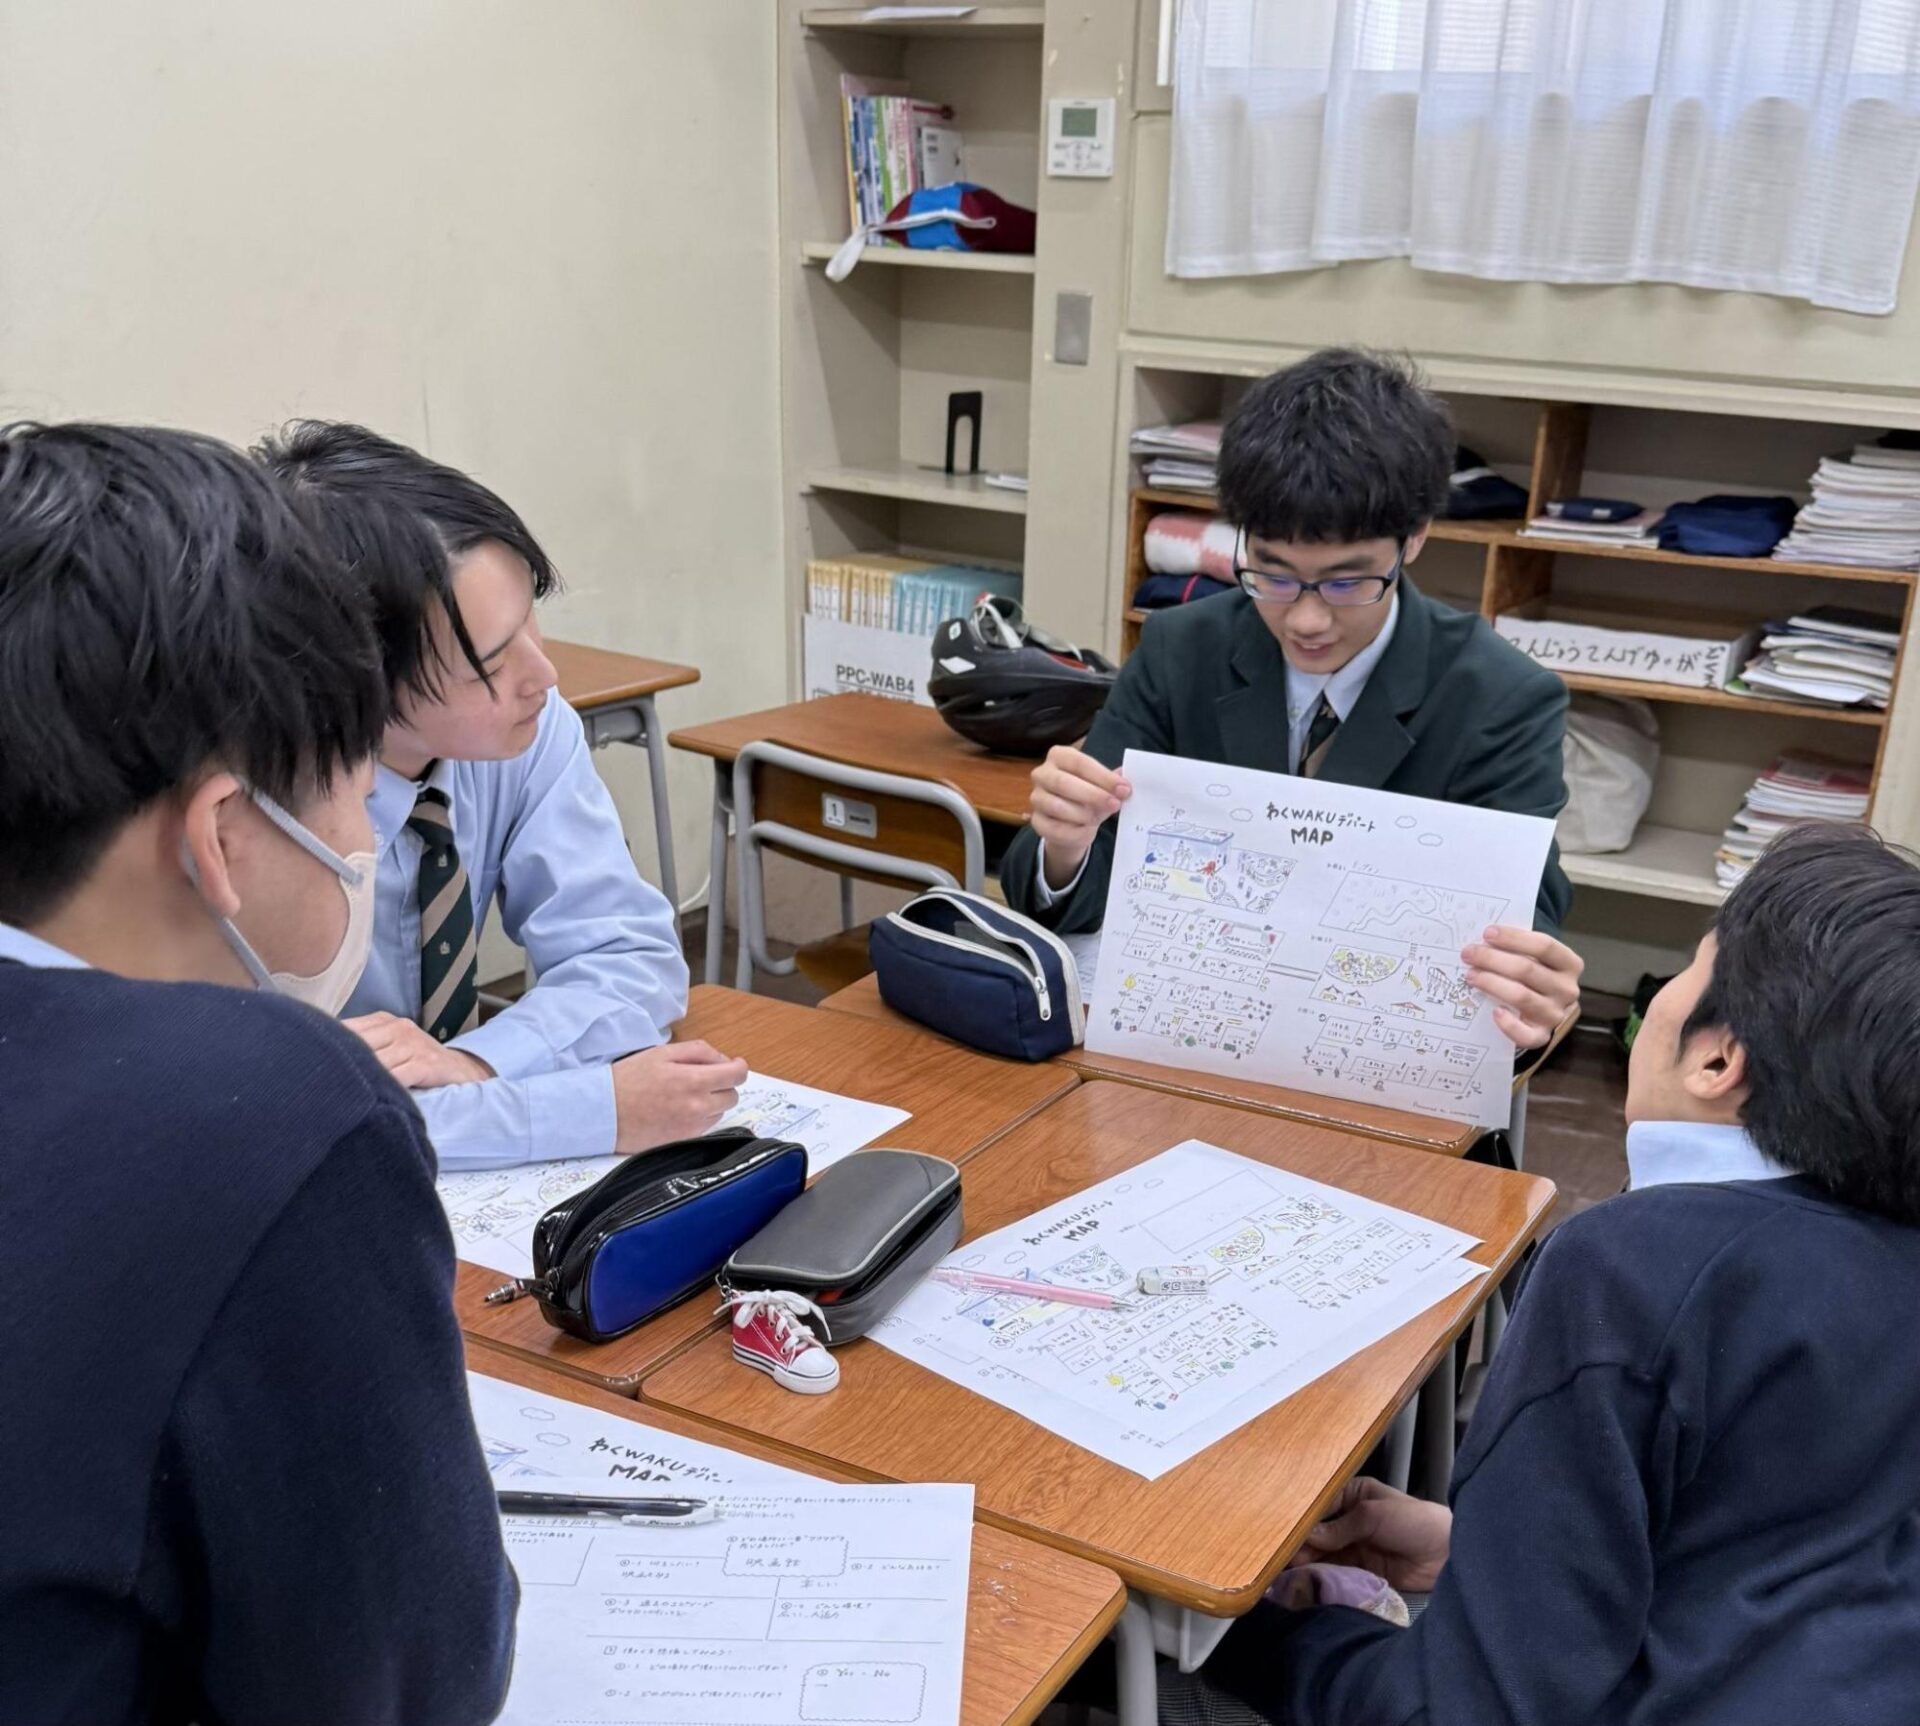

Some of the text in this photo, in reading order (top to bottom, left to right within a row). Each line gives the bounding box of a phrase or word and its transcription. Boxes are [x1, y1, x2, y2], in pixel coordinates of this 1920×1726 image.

[836, 664, 915, 693] PPC-WAB4
[830, 803, 838, 817] 1
[1290, 827, 1334, 846] MAP
[1063, 1220, 1100, 1242] MAP
[874, 1669, 891, 1677] No
